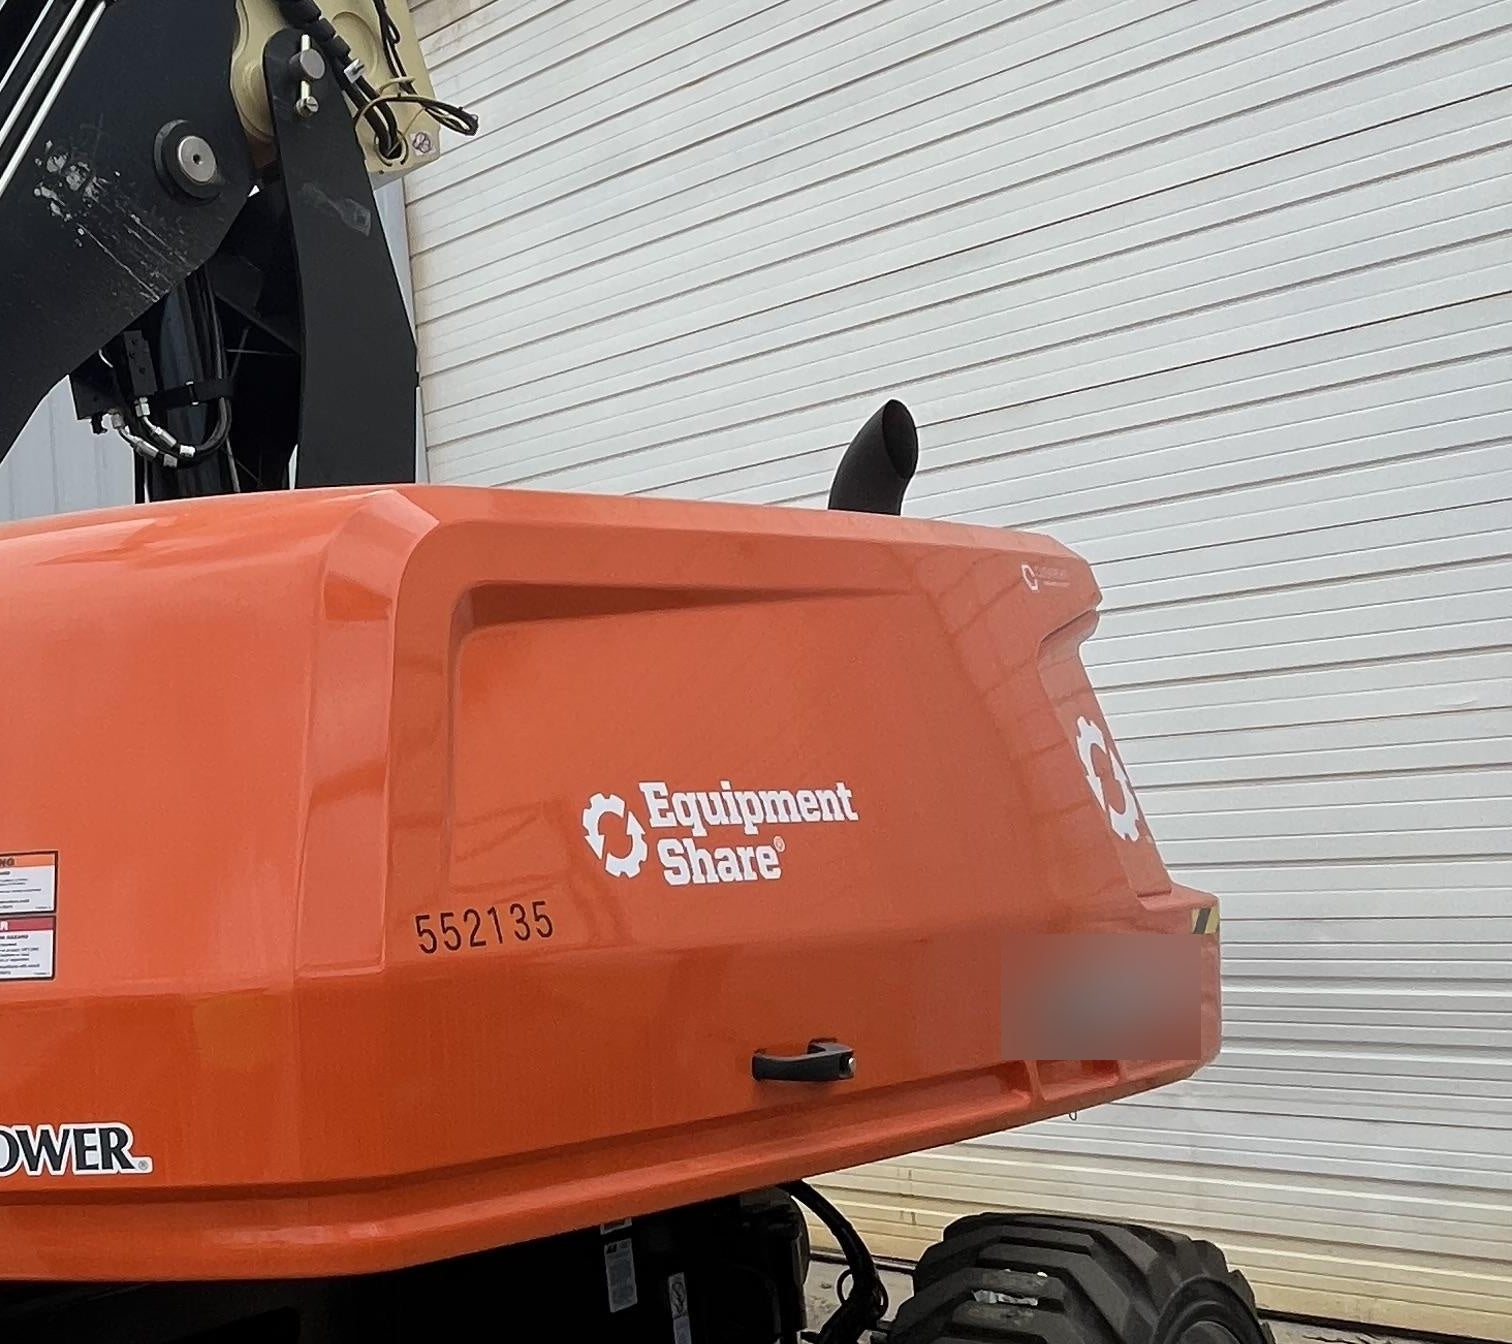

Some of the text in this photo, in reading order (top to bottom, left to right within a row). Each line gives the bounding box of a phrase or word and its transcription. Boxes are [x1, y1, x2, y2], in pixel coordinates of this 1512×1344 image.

[638, 779, 859, 838] Equipment
[656, 837, 783, 886] Share
[414, 900, 554, 955] 552135
